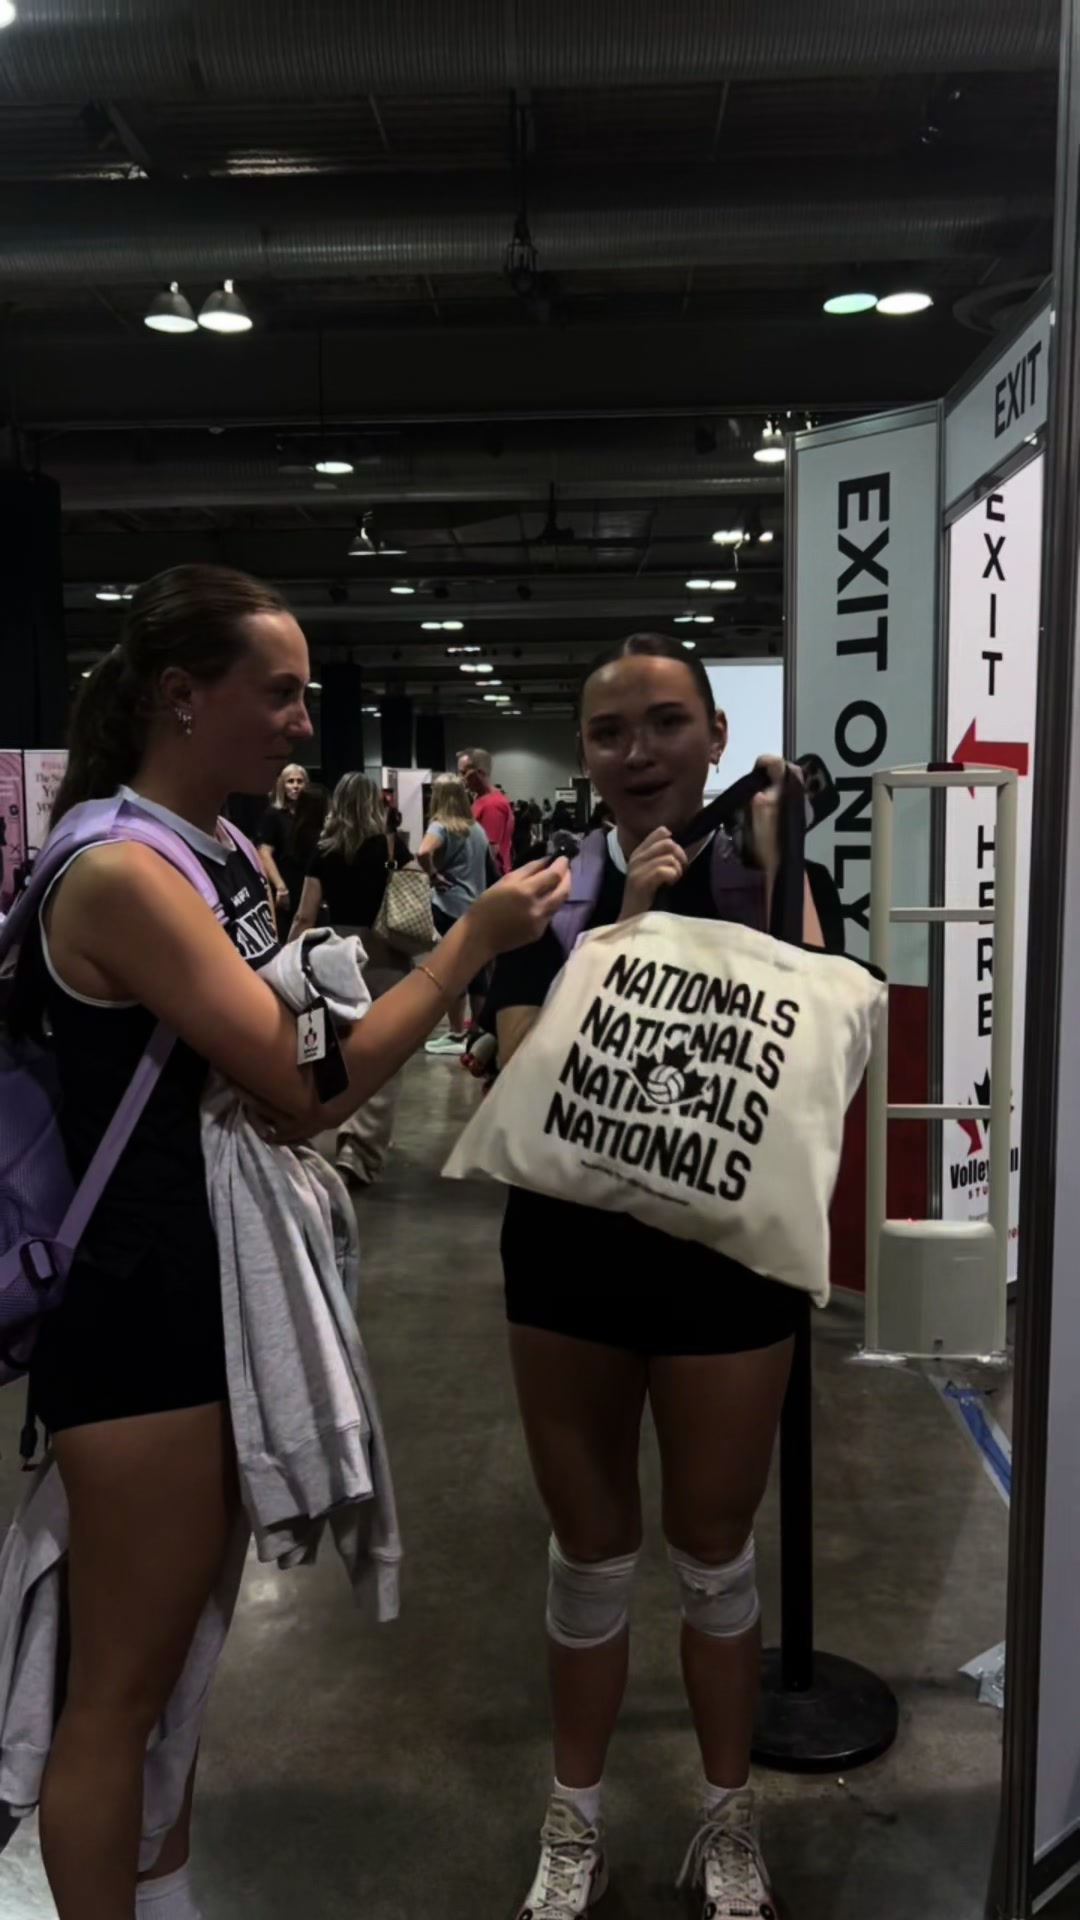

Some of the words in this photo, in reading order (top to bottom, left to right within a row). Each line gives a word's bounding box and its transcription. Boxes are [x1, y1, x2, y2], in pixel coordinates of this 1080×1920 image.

[994, 340, 1042, 439] EXIT
[836, 471, 890, 671] EXIT
[982, 493, 1006, 697] EXIT
[834, 699, 888, 931] ONLY
[603, 953, 800, 1039] NATIONALS
[544, 1091, 752, 1202] NATIONALS
[559, 1041, 769, 1145] NATIALS
